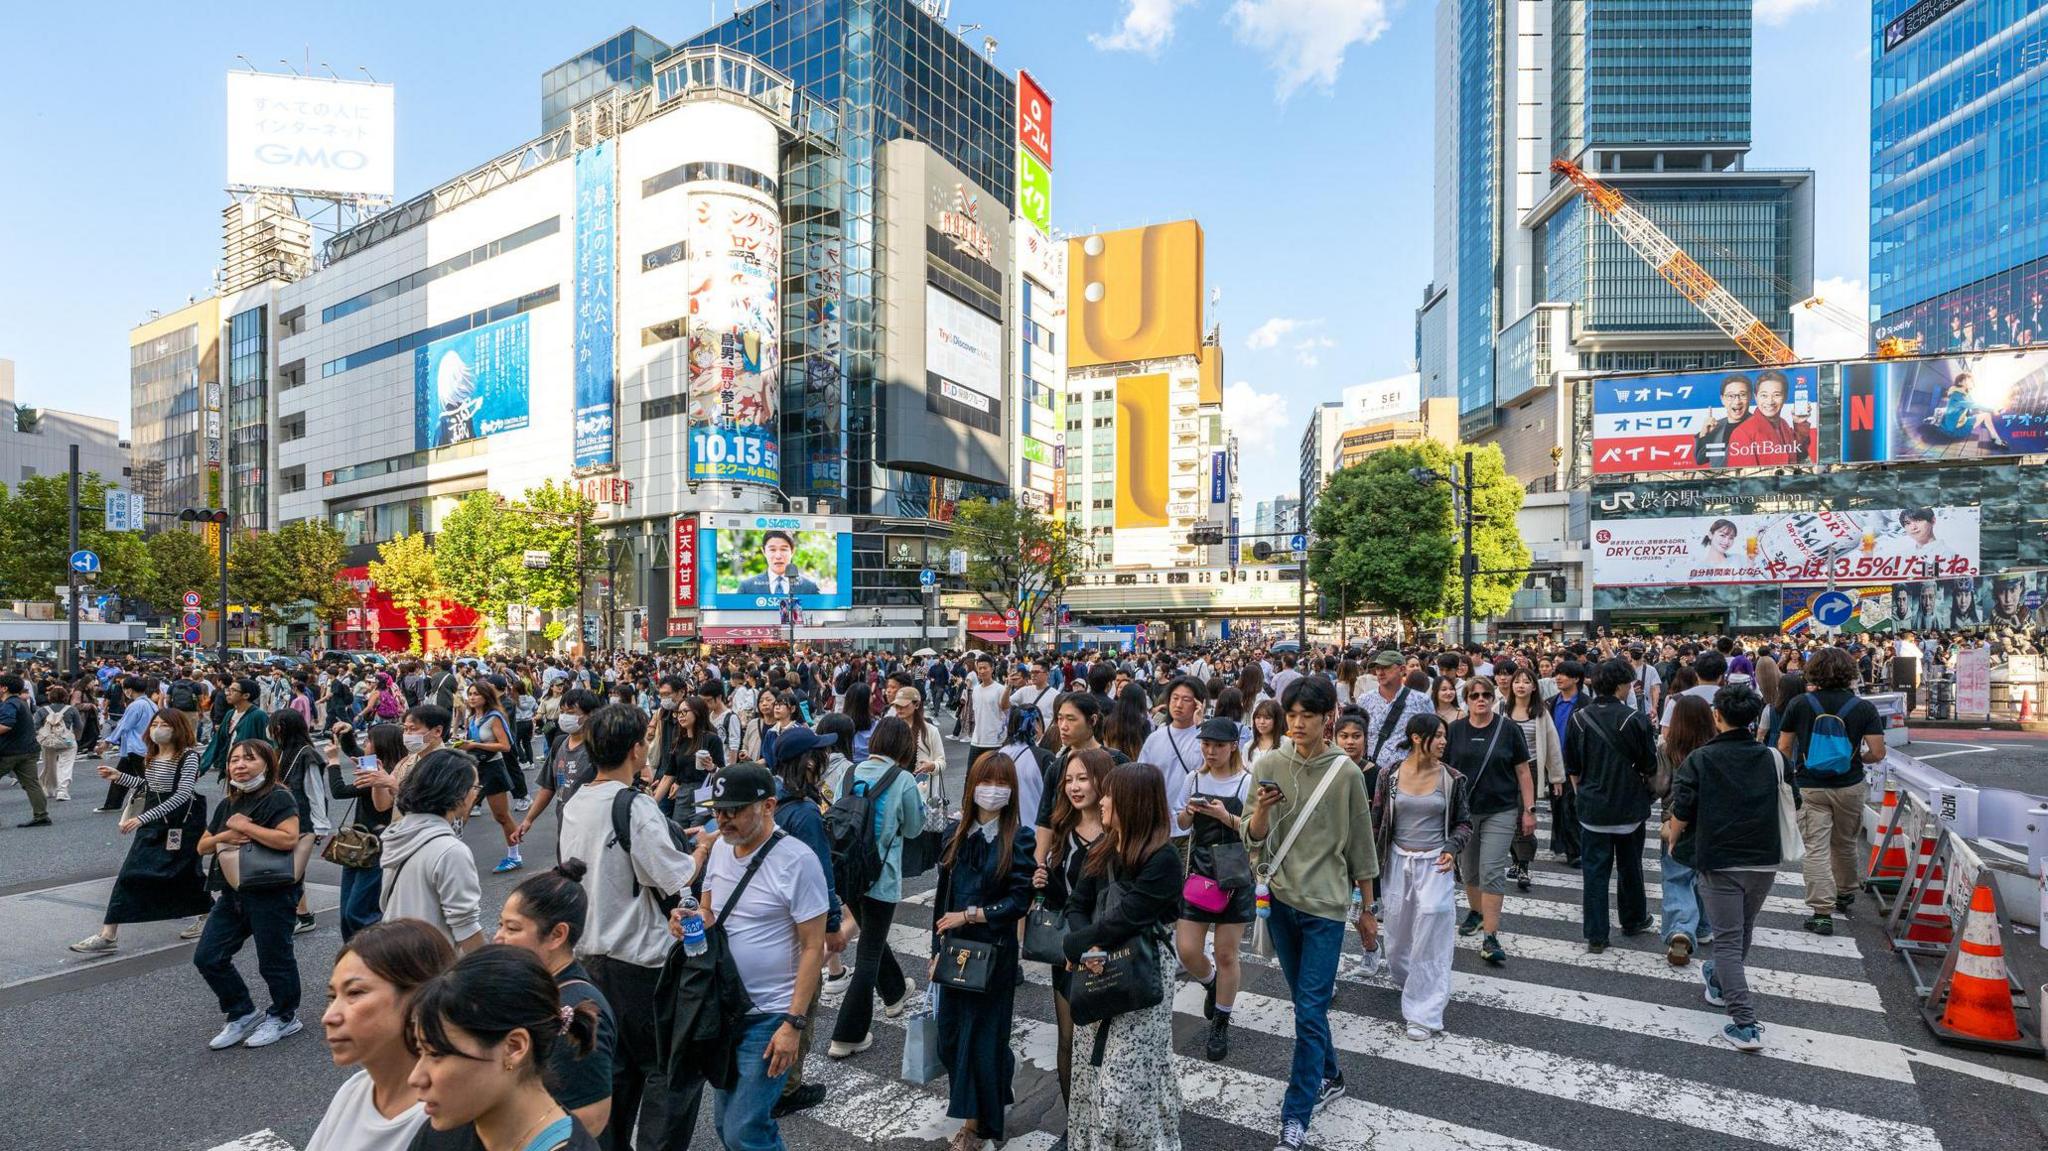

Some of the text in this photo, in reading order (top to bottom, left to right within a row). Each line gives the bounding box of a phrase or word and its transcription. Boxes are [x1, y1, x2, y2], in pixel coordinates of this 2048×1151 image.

[1023, 113, 1049, 154] アコム
[254, 143, 369, 171] GMO
[939, 327, 949, 343] Try
[1634, 385, 1693, 401] オトク
[1614, 415, 1693, 432] オドロク
[1851, 394, 1875, 432] N
[694, 434, 761, 466] 10.13
[1600, 444, 1693, 463] ペイトク
[1729, 440, 1803, 457] SoftBank
[1600, 490, 1802, 511] JR 渋谷駅 shibuya station
[768, 518, 800, 529] STARTS
[1818, 511, 1853, 541] DRY
[1605, 545, 1689, 557] DRY CRYSTAL
[679, 534, 692, 600] 天津甘栗
[714, 777, 726, 798] S
